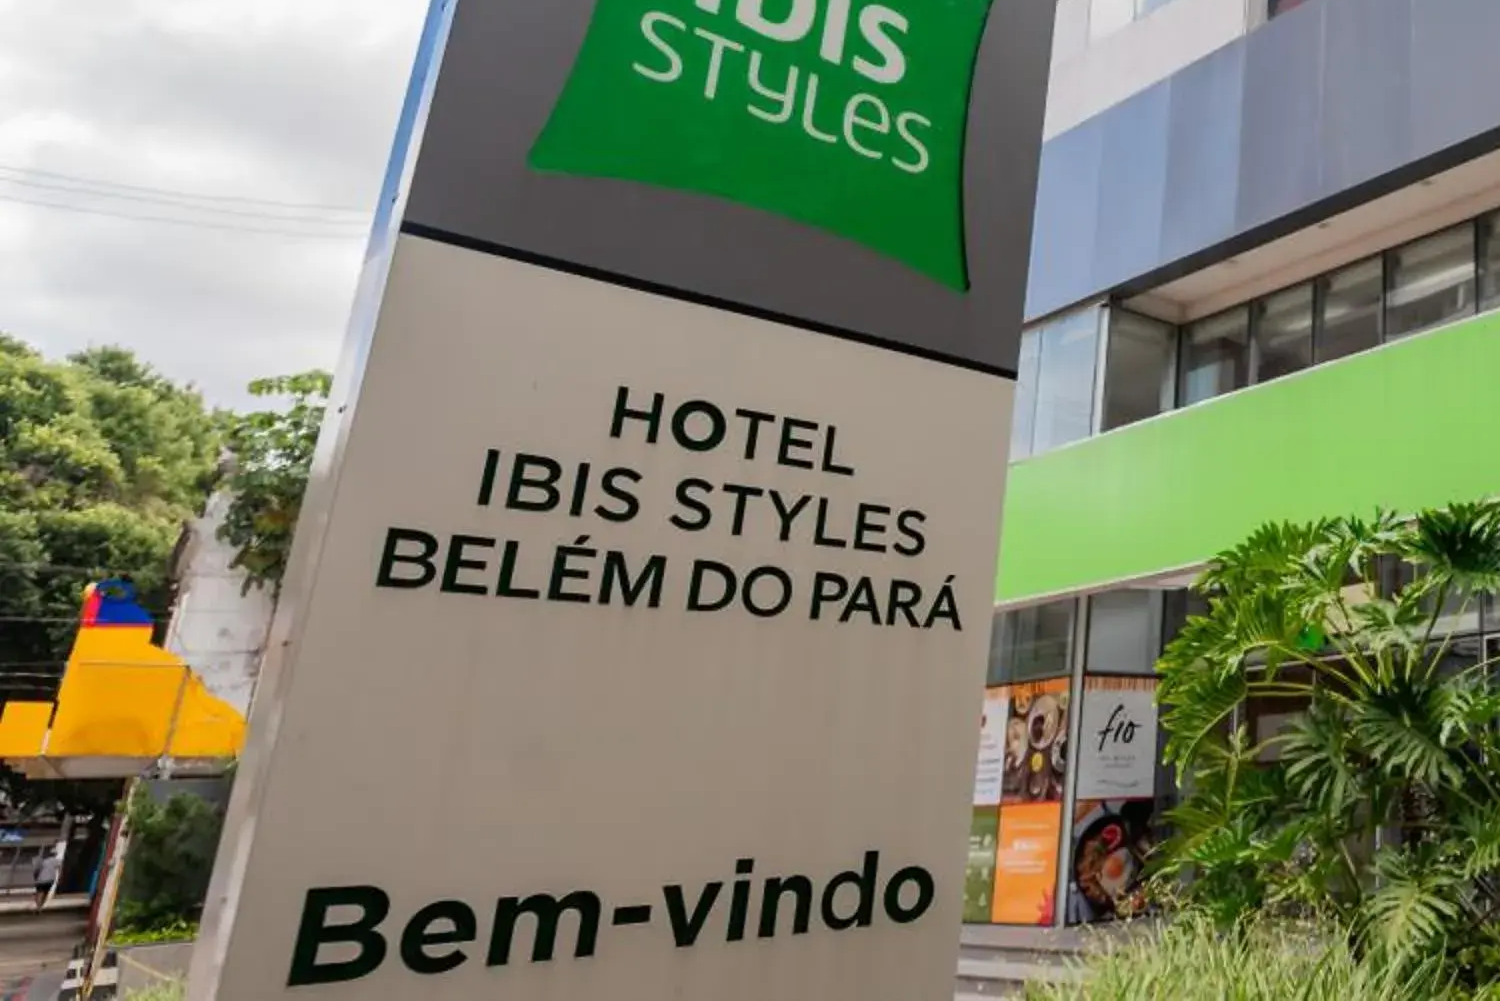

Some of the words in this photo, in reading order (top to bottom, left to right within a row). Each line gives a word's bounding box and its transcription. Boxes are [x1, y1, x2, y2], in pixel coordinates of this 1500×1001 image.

[609, 385, 856, 477] HOTEL
[477, 448, 643, 523] IBIS
[669, 477, 928, 557] STYLES
[375, 527, 668, 609] BELÉM
[686, 559, 793, 618] DO
[808, 572, 963, 632] PARÁ
[285, 850, 936, 989] Bem-vindo
